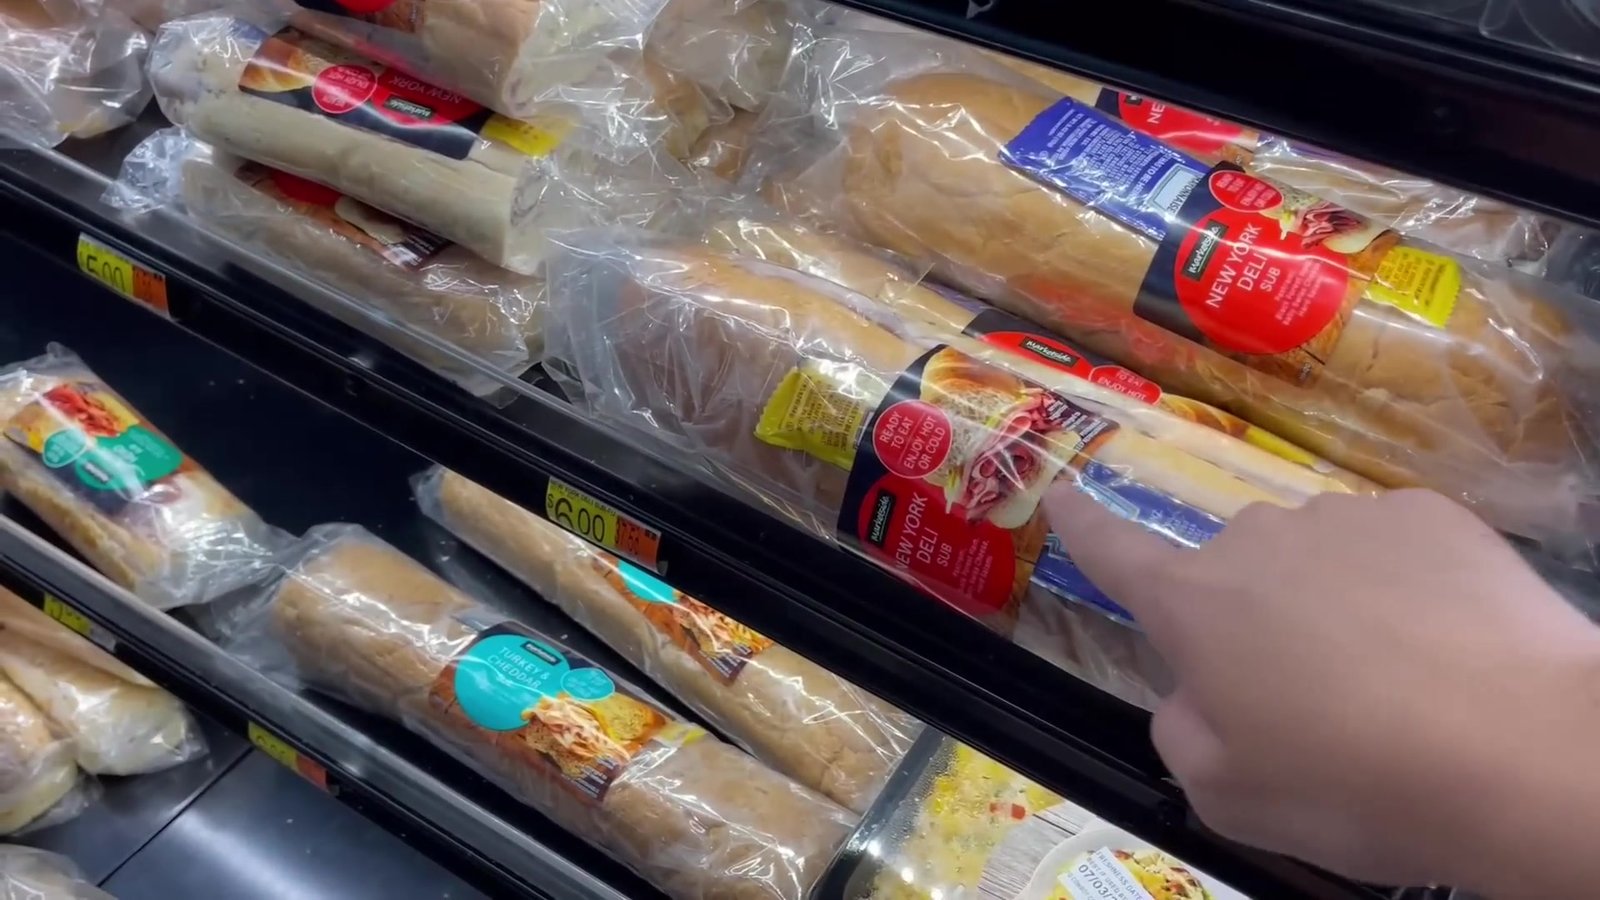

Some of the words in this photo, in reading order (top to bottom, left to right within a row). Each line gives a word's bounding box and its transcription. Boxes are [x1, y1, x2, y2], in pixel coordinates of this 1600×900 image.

[389, 75, 425, 92] YORK
[1145, 101, 1167, 126] NE
[1206, 264, 1237, 309] NEW
[1230, 222, 1261, 267] YORK
[1238, 251, 1268, 293] DELI
[1260, 265, 1282, 294] SUB
[1097, 376, 1127, 393] ENJOY
[1127, 389, 1147, 401] HOT
[879, 410, 903, 444] READY
[891, 433, 906, 450] TO
[898, 416, 914, 436] EAT
[903, 435, 928, 469] ENJOY
[919, 415, 937, 437] HOT
[924, 425, 947, 455] COLD
[917, 452, 933, 470] OR
[902, 491, 929, 537] YORK
[915, 527, 939, 565] DELI
[937, 542, 951, 568] SUB
[487, 653, 542, 690] CHEDDAR
[498, 646, 543, 678] TURKEY
[540, 670, 551, 681] &
[1076, 862, 1119, 900] 07/03/2
[1094, 851, 1130, 886] FRESHNESS
